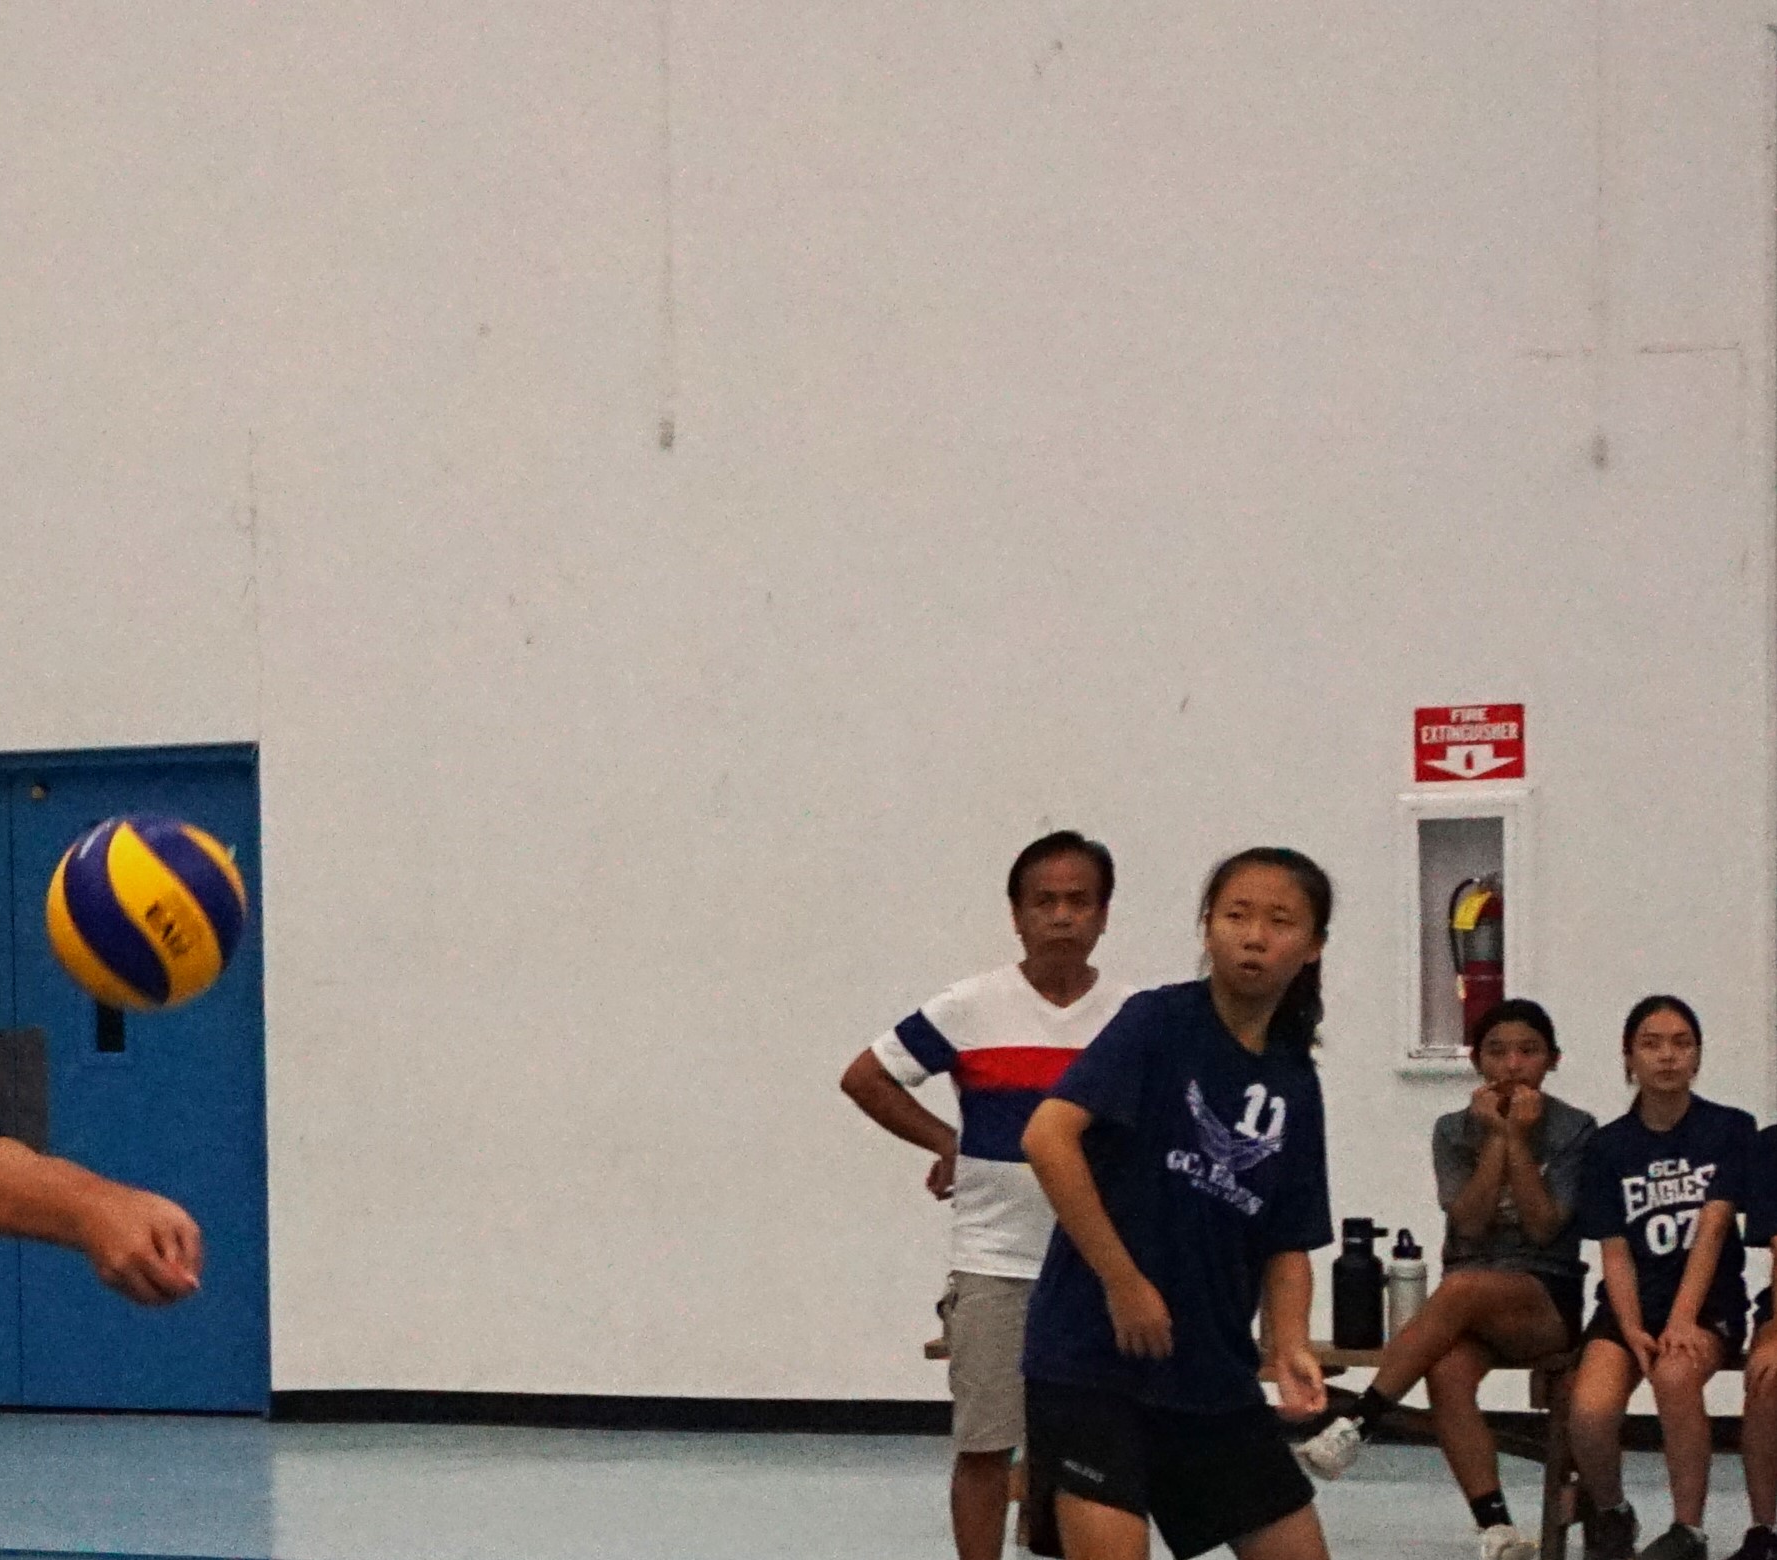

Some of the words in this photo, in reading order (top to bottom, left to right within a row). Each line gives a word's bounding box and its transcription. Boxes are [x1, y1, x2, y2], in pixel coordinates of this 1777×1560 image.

[1450, 706, 1489, 723] FIRE
[1420, 721, 1520, 744] EXTINGUISHER
[1648, 1158, 1691, 1179] GCA
[1645, 1208, 1701, 1255] 07
